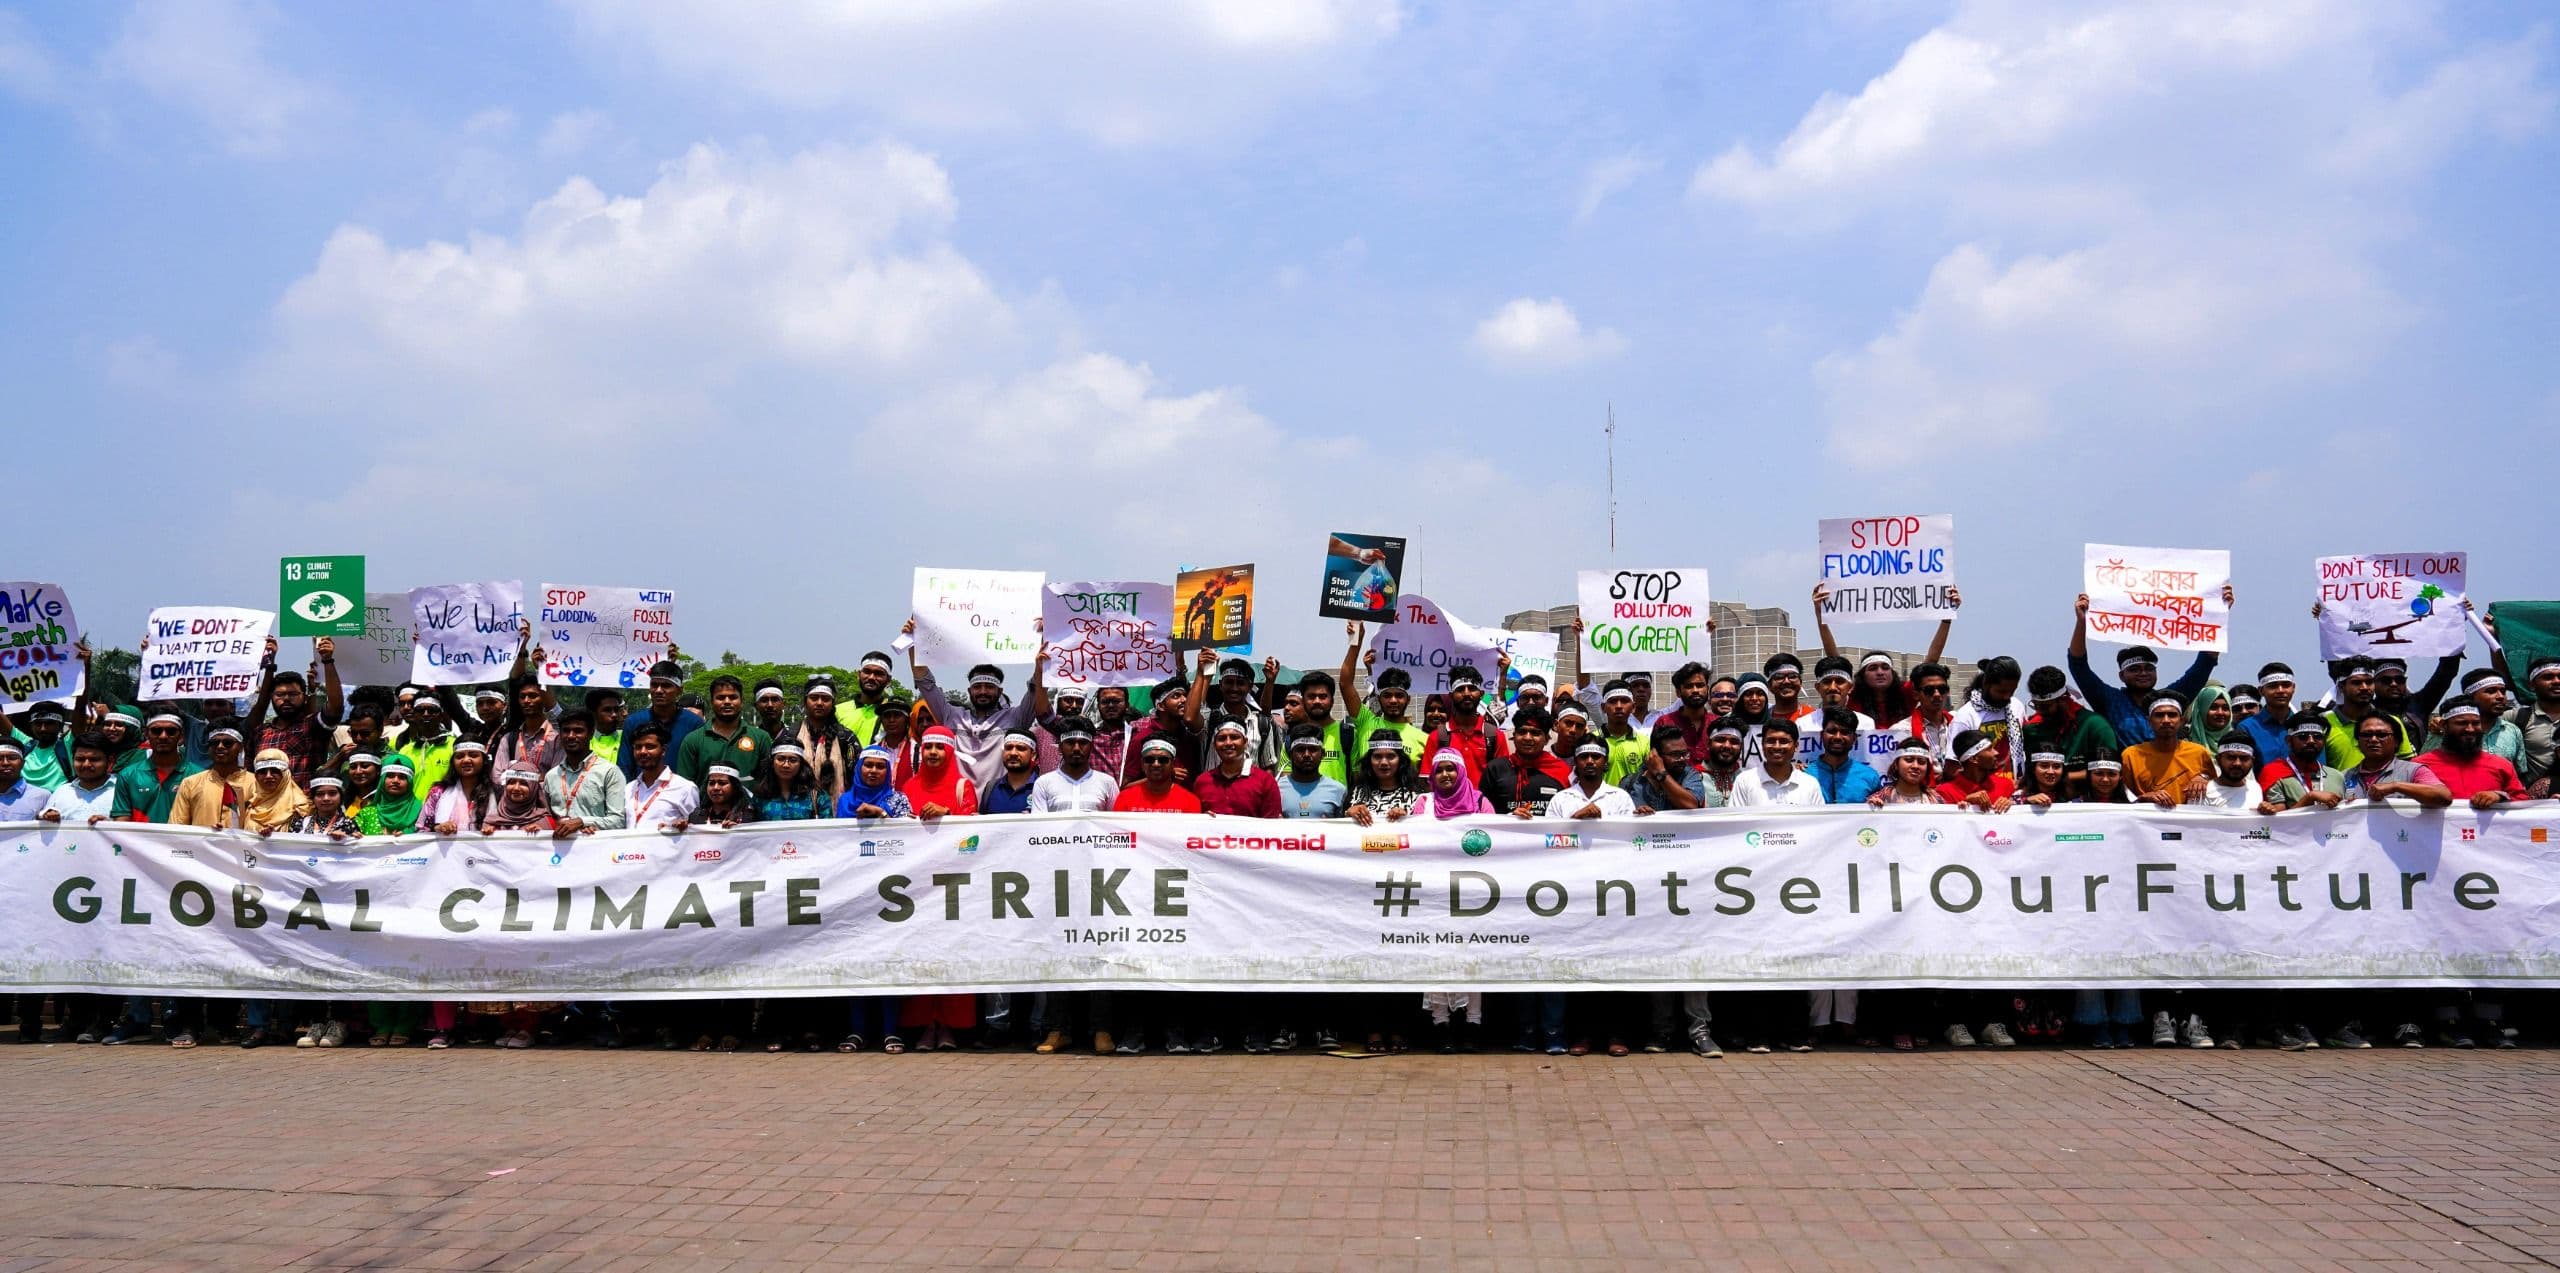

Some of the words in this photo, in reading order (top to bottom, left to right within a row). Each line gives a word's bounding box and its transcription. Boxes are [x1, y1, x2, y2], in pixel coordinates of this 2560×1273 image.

[1852, 516, 1920, 549] STOP
[285, 562, 302, 581] 13
[306, 562, 332, 571] CLIMATE
[1824, 549, 1913, 578] FLOODING
[1919, 548, 1944, 573] US
[2322, 557, 2366, 580] DON'T
[2372, 559, 2416, 579] SELL
[2422, 557, 2461, 576] OUR
[306, 571, 330, 580] ACTION
[1331, 577, 1350, 587] Stop
[1330, 587, 1356, 598] Plastic
[1609, 571, 1682, 603] STOP
[2322, 581, 2404, 603] FUTURE
[546, 589, 586, 606] STOP
[639, 591, 672, 604] WITH
[939, 596, 976, 612] Fund
[1056, 591, 1143, 617] আমরা
[1328, 598, 1364, 608] Pollution
[1822, 587, 1868, 613] WITH
[1873, 586, 1923, 611] FOSSIL
[424, 599, 468, 631] We
[474, 601, 522, 635] Want
[633, 608, 673, 626] FOSSIL
[1224, 614, 1242, 622] From
[1406, 604, 1439, 625] The
[1614, 602, 1692, 618] POLLUTION
[191, 618, 243, 636] DONT
[1222, 621, 1242, 630] Fossil
[1226, 629, 1241, 637] Fuel
[552, 630, 571, 642] US
[633, 629, 671, 643] FUELS
[986, 632, 1036, 652] Future
[159, 640, 203, 656] WANT
[203, 639, 227, 654] TO
[230, 639, 254, 655] BE
[427, 642, 475, 667] Clean
[1384, 638, 1424, 668] Fund
[1133, 642, 1174, 675] চাই
[1514, 654, 1556, 673] EARTH
[150, 660, 217, 680] CLIMATE
[1028, 836, 1071, 846] GLOBAL
[1762, 831, 1794, 839] Climate
[1762, 838, 1798, 846] Frontiers
[1372, 862, 2501, 917] #DontSellOurFuture
[52, 876, 384, 933] GLOBAL
[439, 879, 822, 933] CLIMATE
[877, 868, 1189, 923] STRIKE
[1063, 928, 1078, 943] 11
[1082, 926, 1130, 946] April
[1136, 928, 1187, 943] 2025
[1381, 931, 1430, 944] Manik
[1436, 931, 1464, 944] Mia
[1468, 932, 1530, 944] Avenue
